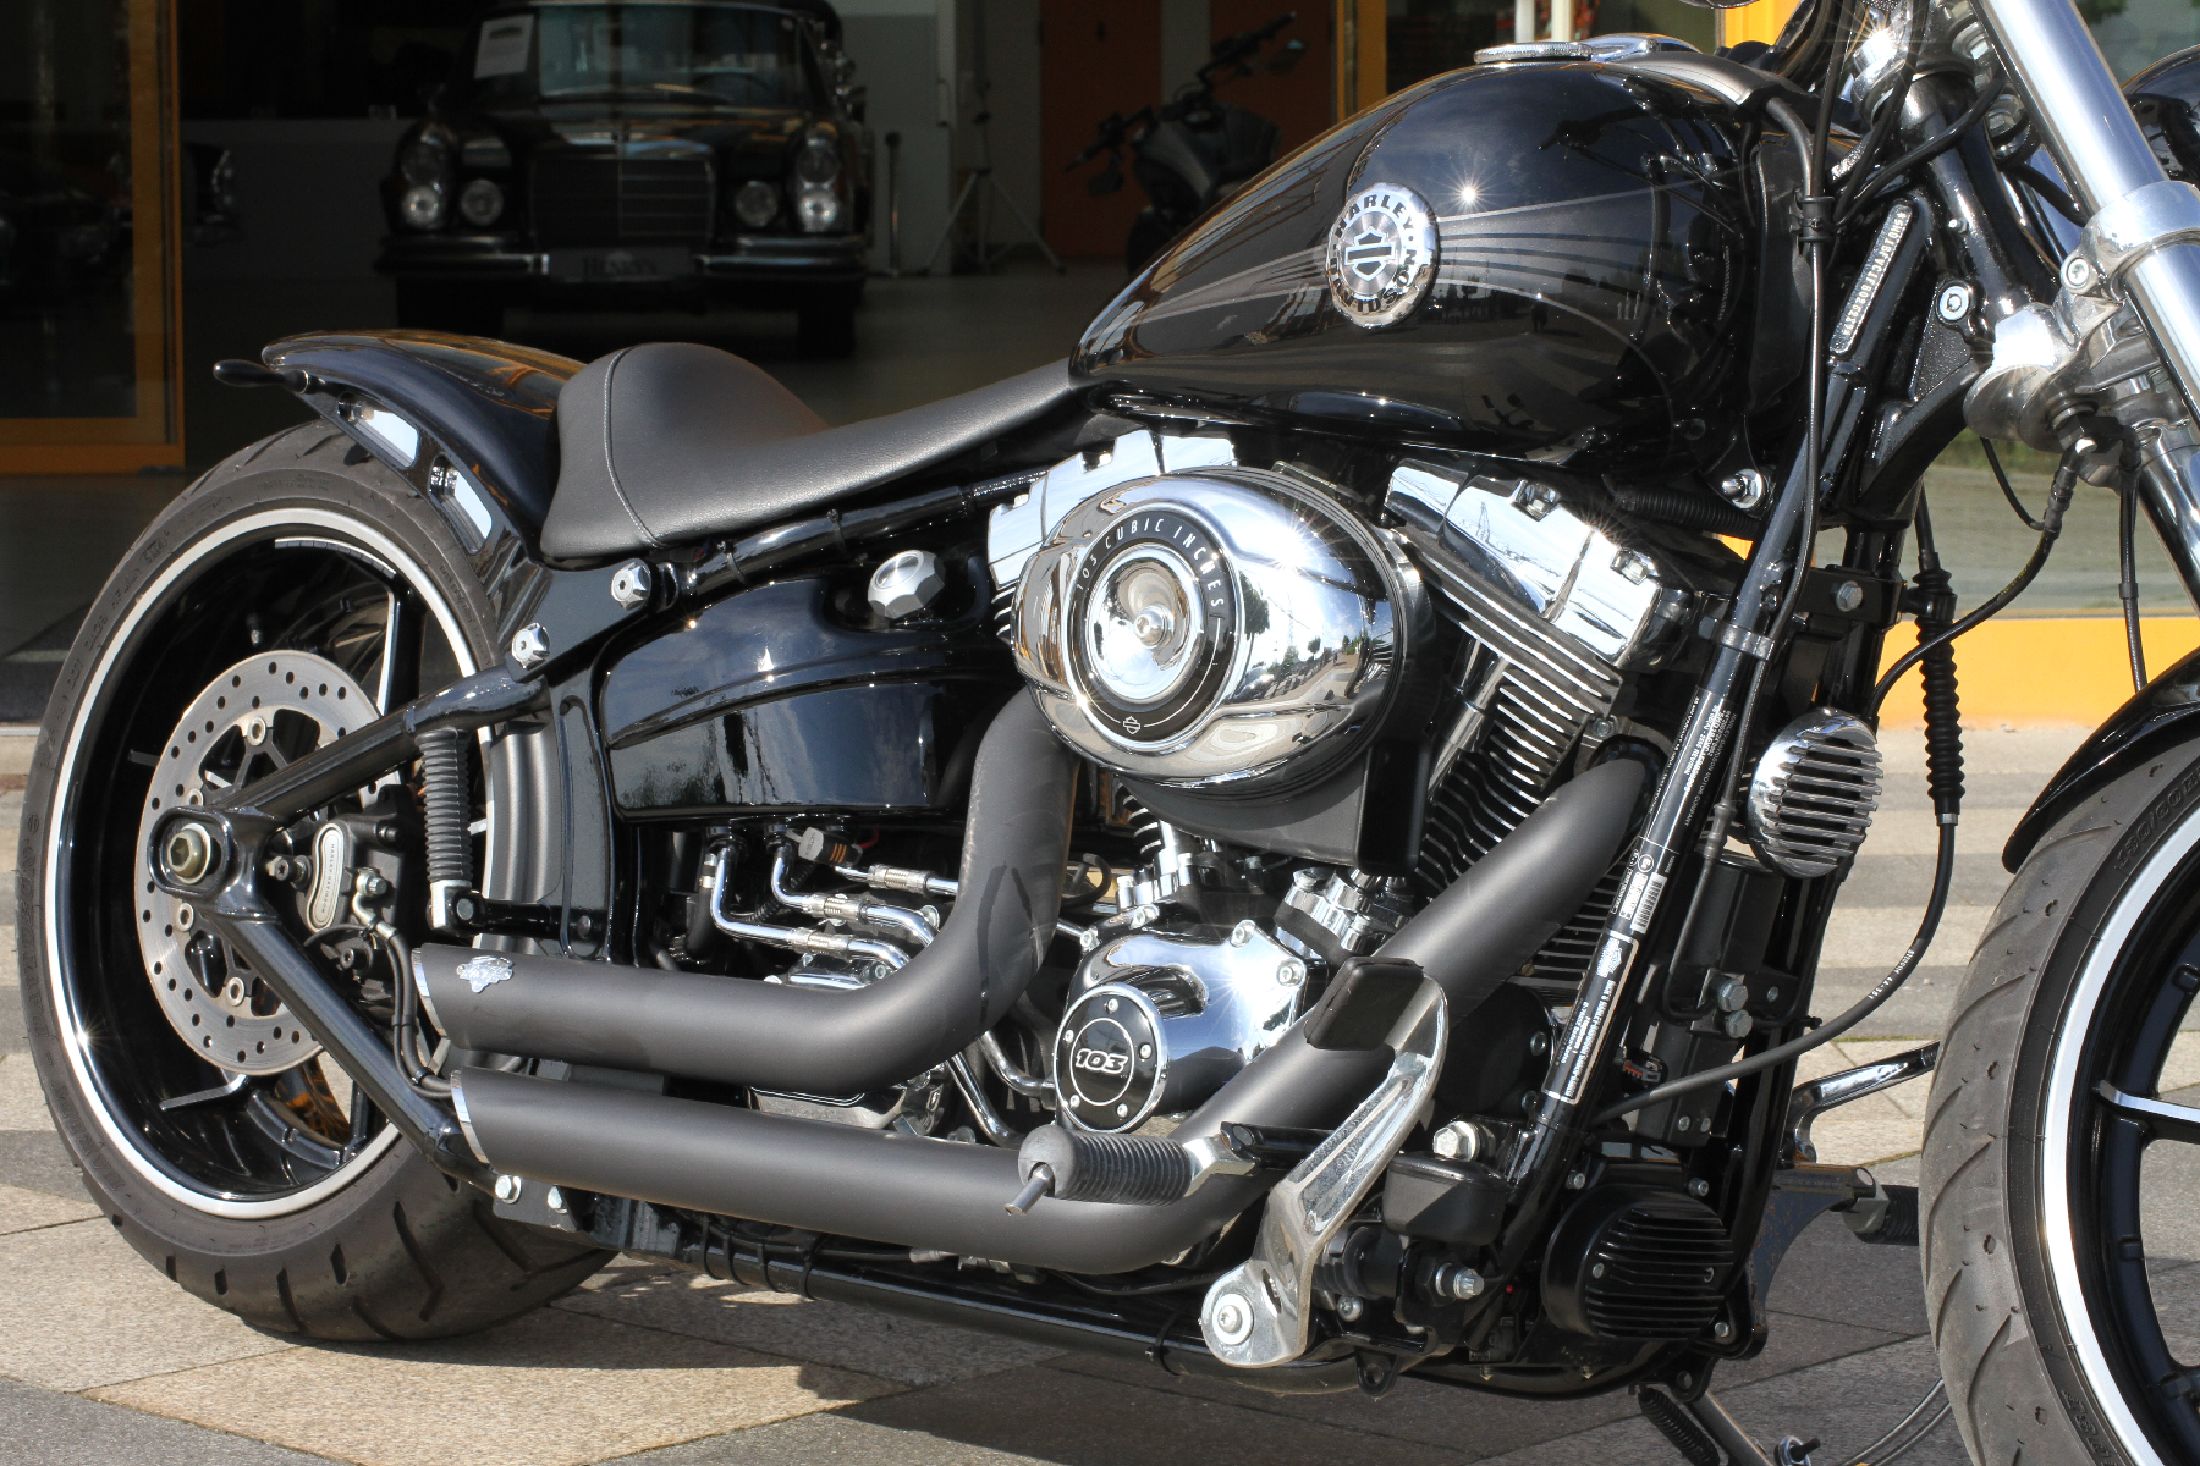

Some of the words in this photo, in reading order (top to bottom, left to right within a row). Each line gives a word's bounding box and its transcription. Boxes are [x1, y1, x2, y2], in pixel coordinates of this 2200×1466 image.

[1105, 518, 1165, 550] CUBIC
[1172, 525, 1224, 608] INCHES
[1075, 1048, 1129, 1074] 103
